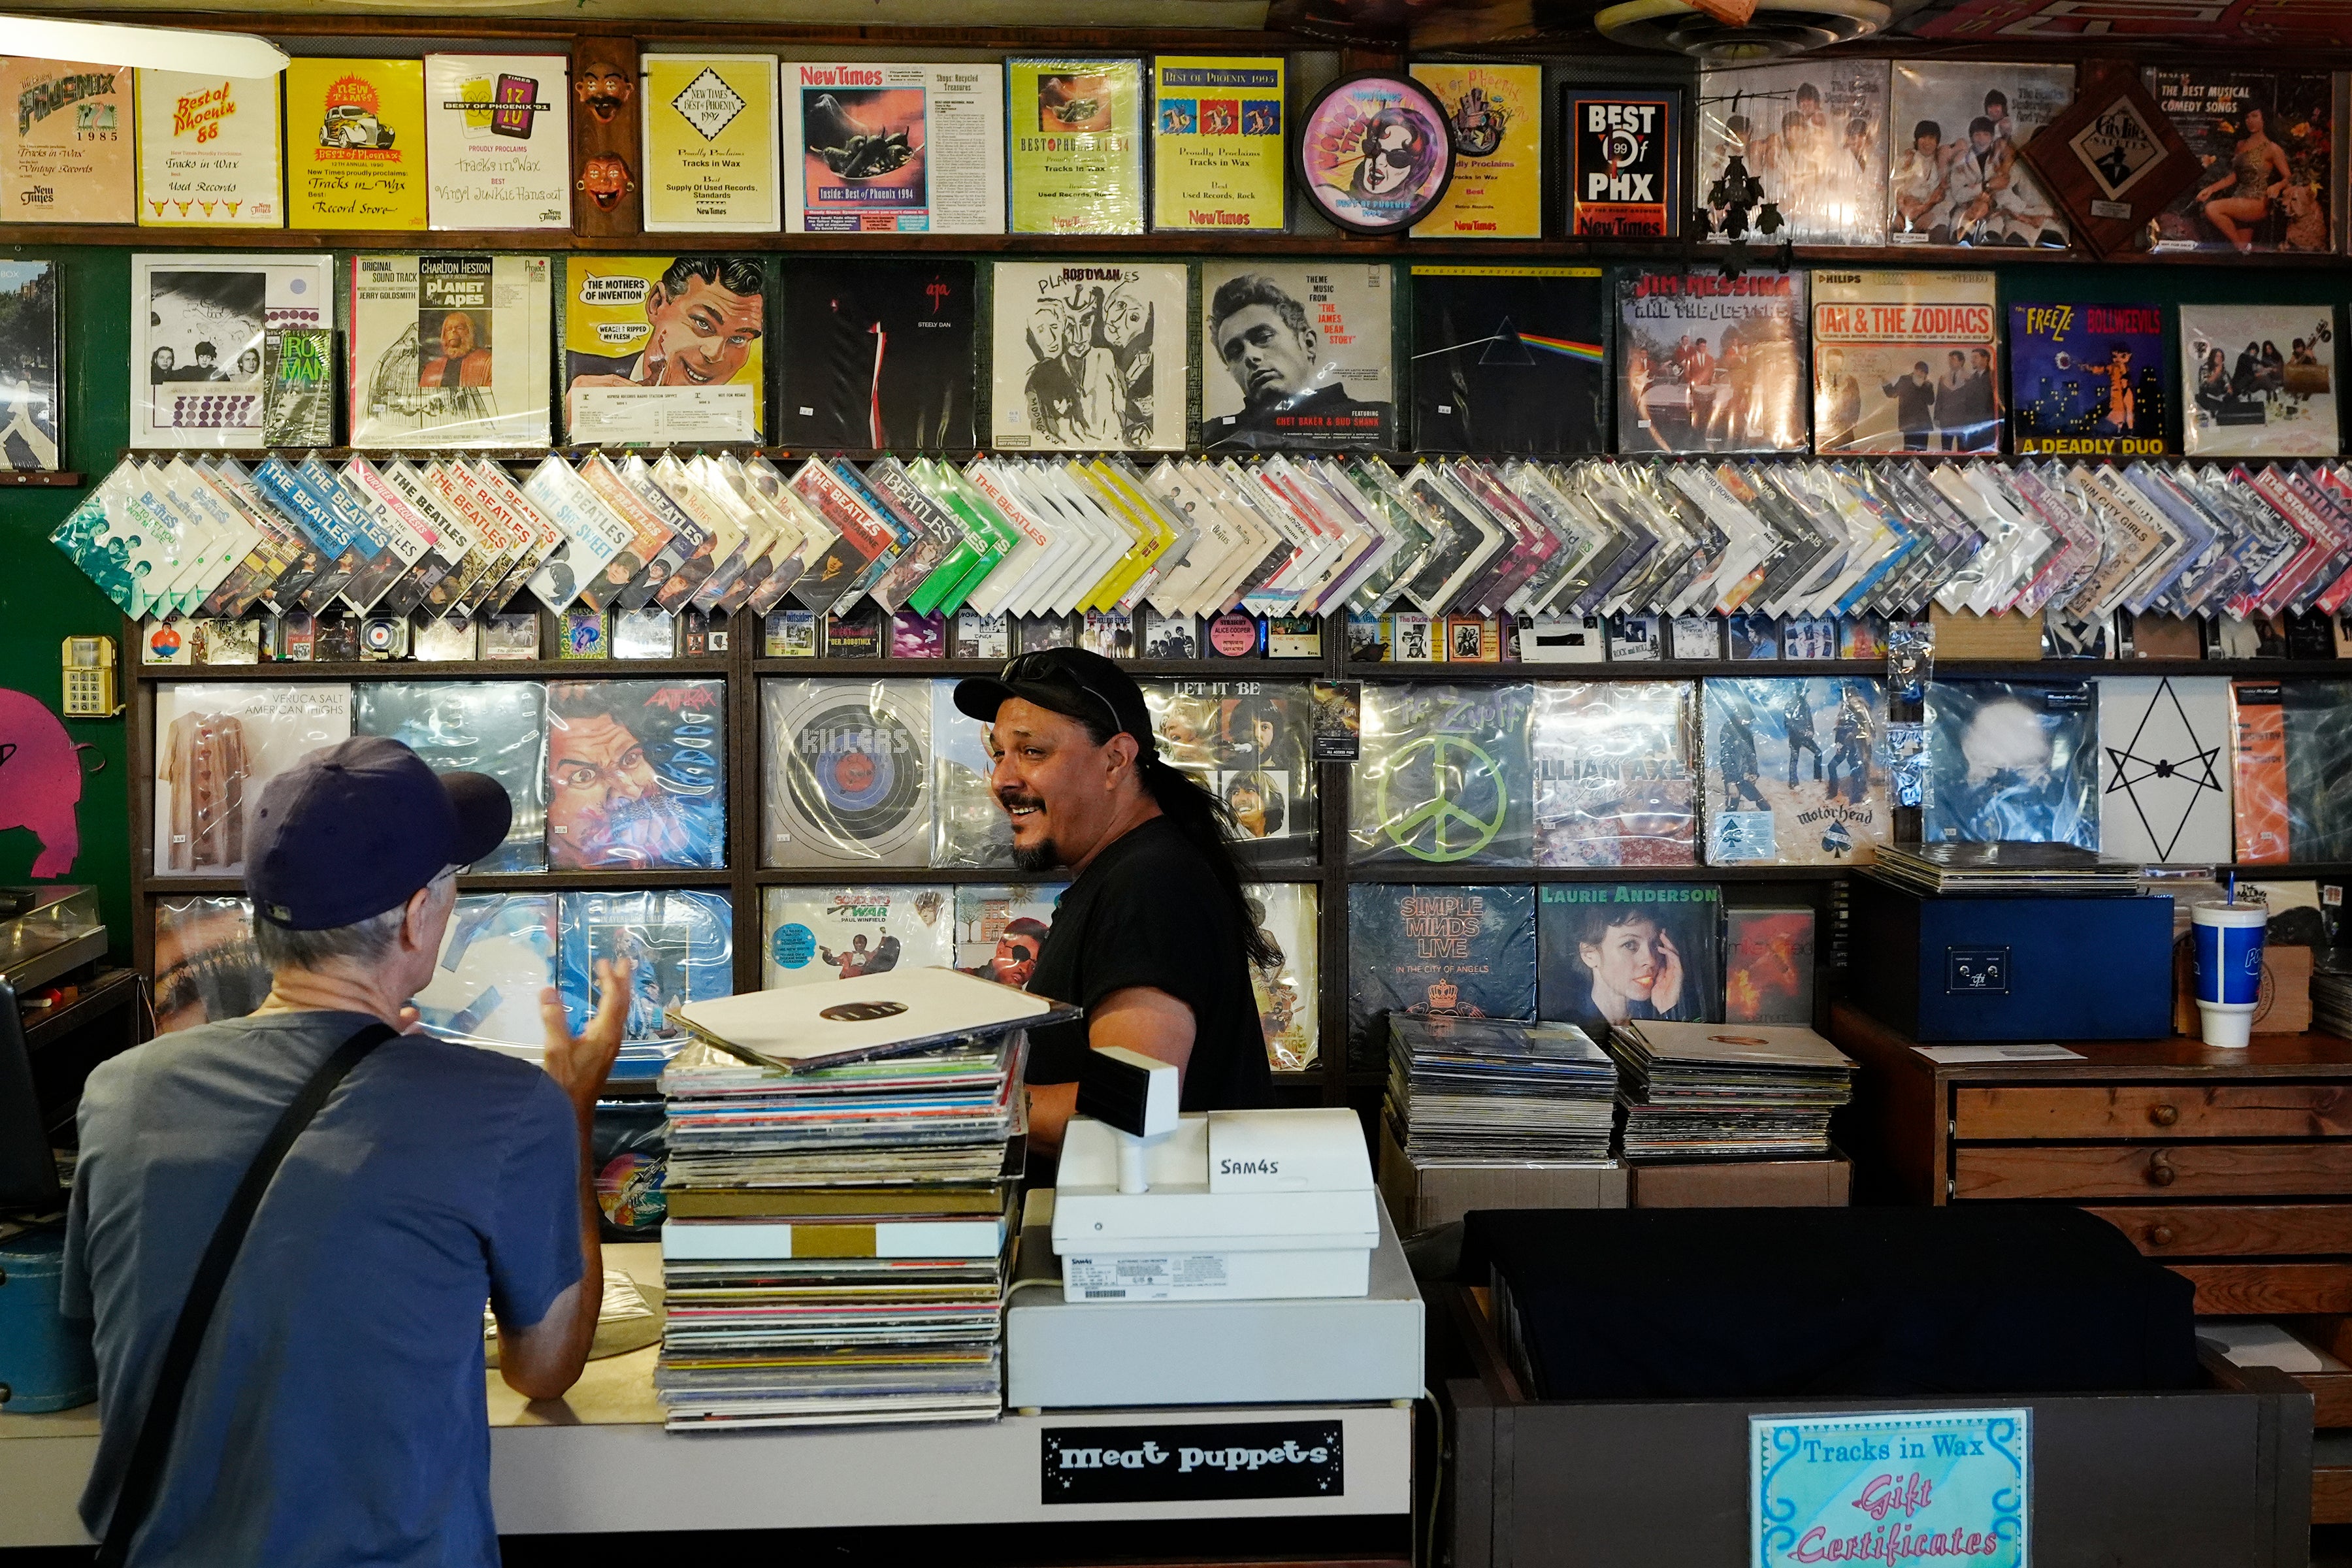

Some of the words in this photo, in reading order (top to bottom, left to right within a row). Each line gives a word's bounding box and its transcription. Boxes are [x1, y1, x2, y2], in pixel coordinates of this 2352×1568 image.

[178, 90, 210, 117] Best
[213, 81, 229, 101] of
[2161, 85, 2178, 96] THE
[2183, 86, 2204, 97] BEST
[2208, 86, 2249, 99] MUSICAL
[18, 73, 116, 137] PHOENIX
[2161, 101, 2202, 112] COMEDY
[2205, 101, 2238, 114] SONGS
[174, 101, 235, 136] Phoenix
[1589, 105, 1656, 133] BEST
[76, 132, 118, 141] 1985
[197, 122, 218, 143] 88
[59, 149, 85, 157] Wax
[1179, 147, 1213, 156] Proudly
[1218, 148, 1260, 156] Proclaims
[1614, 143, 1627, 154] 99
[19, 166, 56, 176] Vintage
[166, 158, 196, 168] Tracks
[201, 159, 209, 168] in
[214, 159, 239, 169] Wax
[34, 186, 54, 195] New
[169, 182, 190, 191] Used
[196, 183, 236, 191] Records
[820, 188, 844, 199] Inside:
[845, 188, 860, 199] Best
[861, 188, 870, 199] of
[870, 188, 896, 199] Phoenix
[898, 188, 913, 199] 1994
[1588, 173, 1654, 201] PHX
[21, 192, 54, 205] Times
[312, 199, 357, 214] Record
[360, 203, 398, 214] Store
[362, 262, 392, 272] ORIGINAL
[421, 260, 460, 274] CHARLTON
[461, 259, 490, 274] HESTON
[372, 273, 395, 282] SOUND
[397, 272, 417, 282] TRACK
[588, 280, 604, 289] THE
[606, 280, 644, 289] MOTHERS
[1819, 275, 1861, 284] PHILIPS
[585, 291, 596, 300] OF
[598, 291, 642, 299] INVENTION
[926, 275, 951, 314] aja
[1635, 276, 1678, 298] JIM
[1686, 276, 1790, 298] MESSINA
[1819, 308, 1850, 333] IAN
[1855, 308, 1868, 333] &
[1871, 308, 1906, 333] THE
[1912, 308, 1989, 334] ZODIACS
[2026, 305, 2074, 341] FREEZE
[1030, 397, 1059, 444] MOONGLOW
[1277, 417, 1295, 425] CHET
[1299, 417, 1322, 425] BAKER
[1354, 417, 1379, 425] SHANK
[2022, 440, 2034, 452] A
[2042, 439, 2115, 455] DEADLY
[2122, 439, 2163, 453] DUO
[1699, 468, 1716, 485] DAVID
[1716, 485, 1737, 506] BOWIE
[266, 463, 294, 493] THE
[293, 489, 350, 546] BEATLES
[305, 463, 334, 492] THE
[331, 491, 387, 549] BEATLES
[392, 471, 415, 497] THE
[416, 495, 466, 547] BEATLES
[451, 465, 477, 488] THE
[477, 489, 530, 544] BEATLES
[806, 465, 829, 490] THE
[830, 485, 882, 536] BEATLES
[977, 474, 995, 498] THE
[996, 495, 1047, 546] BEATLES
[393, 502, 427, 535] REQUESTS
[2097, 493, 2115, 514] CITY
[2120, 517, 2148, 542] GIRLS
[308, 521, 338, 549] WRITER
[1173, 682, 1206, 695] LET
[1213, 682, 1230, 695] IT
[1236, 682, 1260, 695] BE
[272, 694, 316, 704] VERUCA
[319, 694, 343, 704] SALT
[644, 685, 717, 712] ANTHRAX
[246, 705, 303, 715] AMERICAN
[802, 728, 909, 753] KILLERS
[1631, 760, 1688, 779] AXE
[1541, 887, 1608, 903] LAURIE
[1614, 887, 1717, 903] ANDERSON
[1400, 897, 1484, 916] SIMPLE
[1407, 918, 1480, 937] MINDS
[1418, 939, 1468, 958] LIVE
[1059, 1441, 1169, 1469] meat
[1178, 1440, 1328, 1472] puppets
[1803, 1437, 1890, 1463] Tracks
[1899, 1437, 1925, 1459] in
[1932, 1434, 1984, 1457] Wax
[1852, 1472, 1933, 1520] Gift
[1788, 1522, 1998, 1567] Certificates
